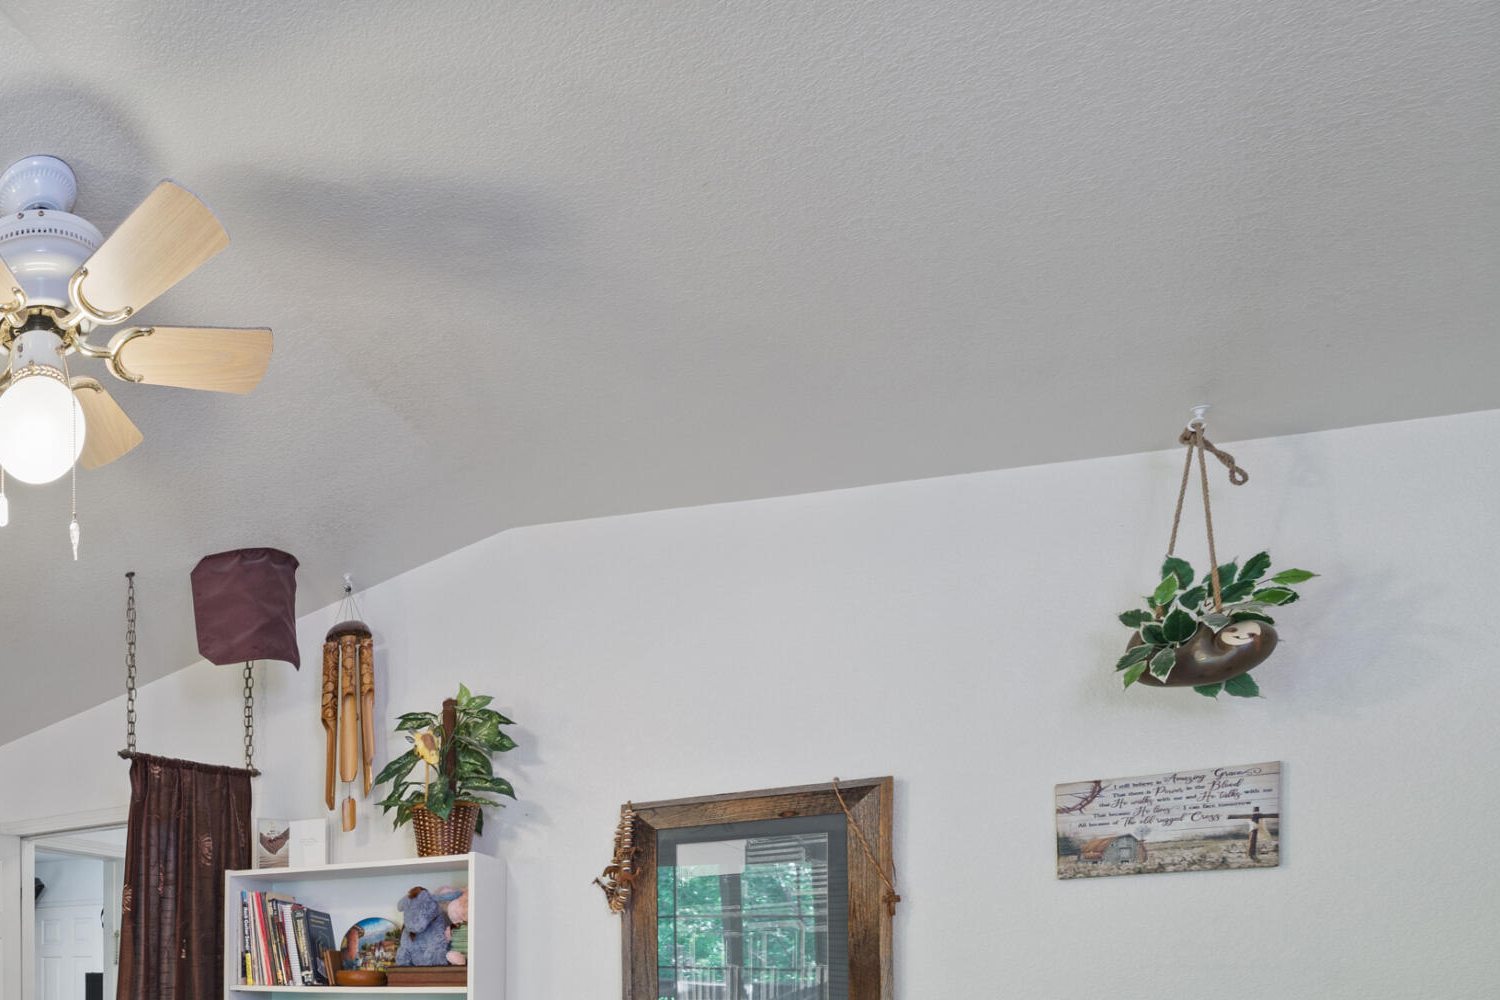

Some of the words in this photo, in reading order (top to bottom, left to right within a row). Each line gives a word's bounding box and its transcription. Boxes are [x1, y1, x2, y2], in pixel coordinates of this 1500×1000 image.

[1166, 773, 1206, 784] Amazing
[1213, 768, 1252, 780] Grace
[1207, 778, 1244, 792] Blood
[1190, 811, 1221, 822] Cross
